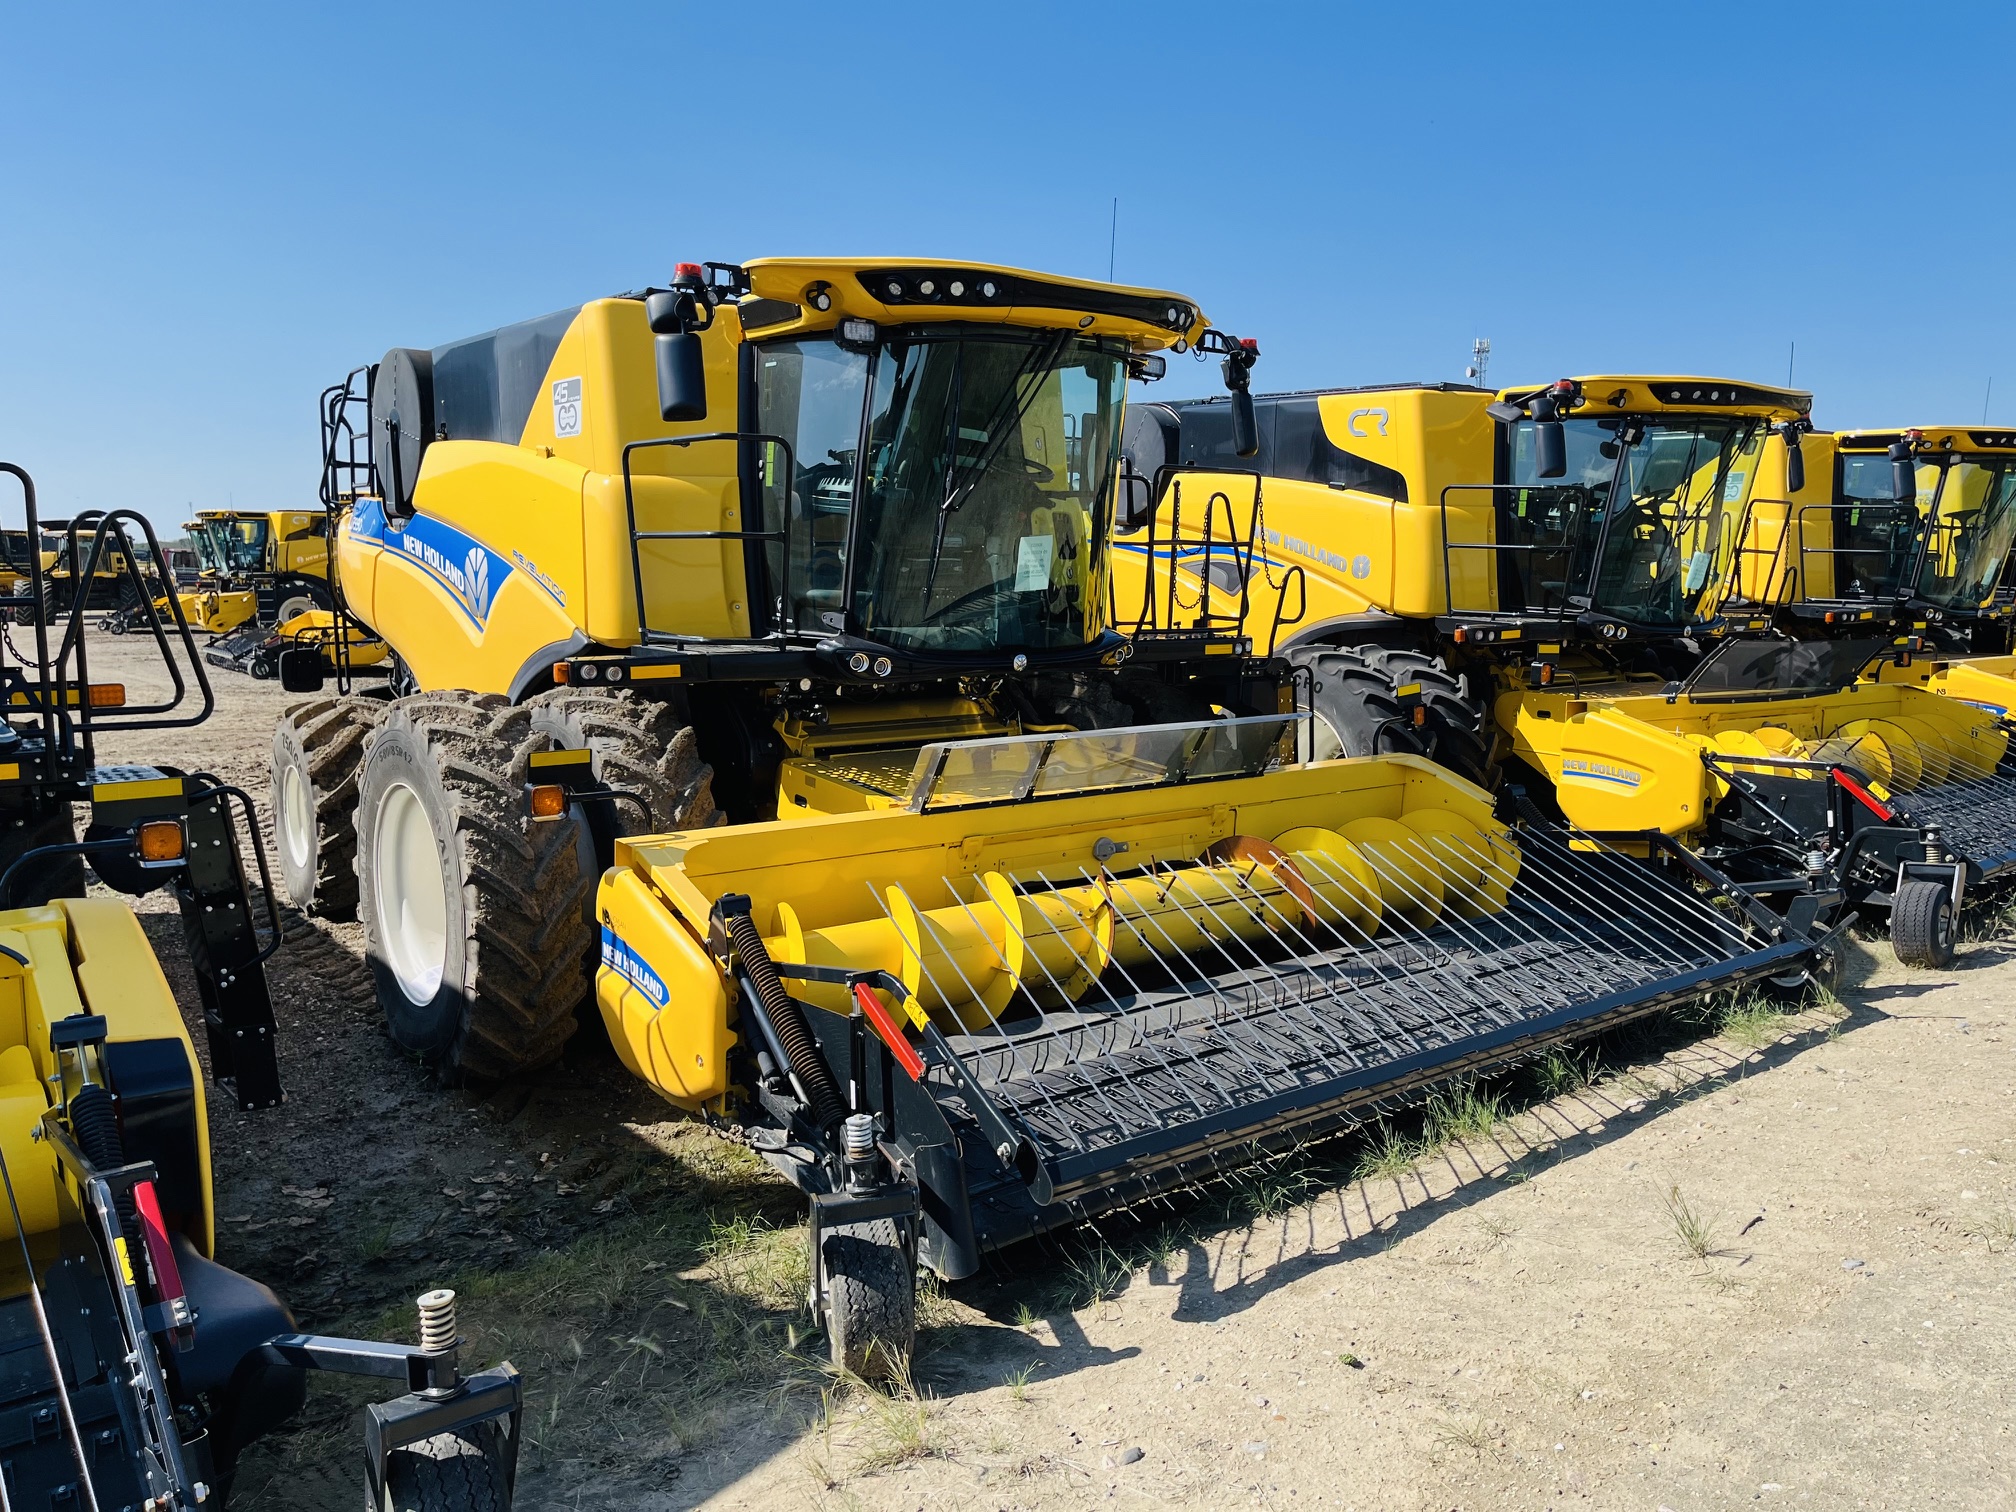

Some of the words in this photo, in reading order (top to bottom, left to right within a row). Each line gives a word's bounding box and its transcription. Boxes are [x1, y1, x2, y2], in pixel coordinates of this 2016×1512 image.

[1347, 407, 1389, 437] CR
[403, 533, 423, 559] NEW
[423, 543, 465, 592] HOLLAND
[512, 549, 567, 603] REVELATION
[1283, 534, 1348, 573] HOLLAND
[1562, 758, 1588, 771] NEW
[1589, 762, 1642, 784] HOLLAND
[602, 941, 622, 967] NEW
[623, 954, 663, 1001] HOLLAND
